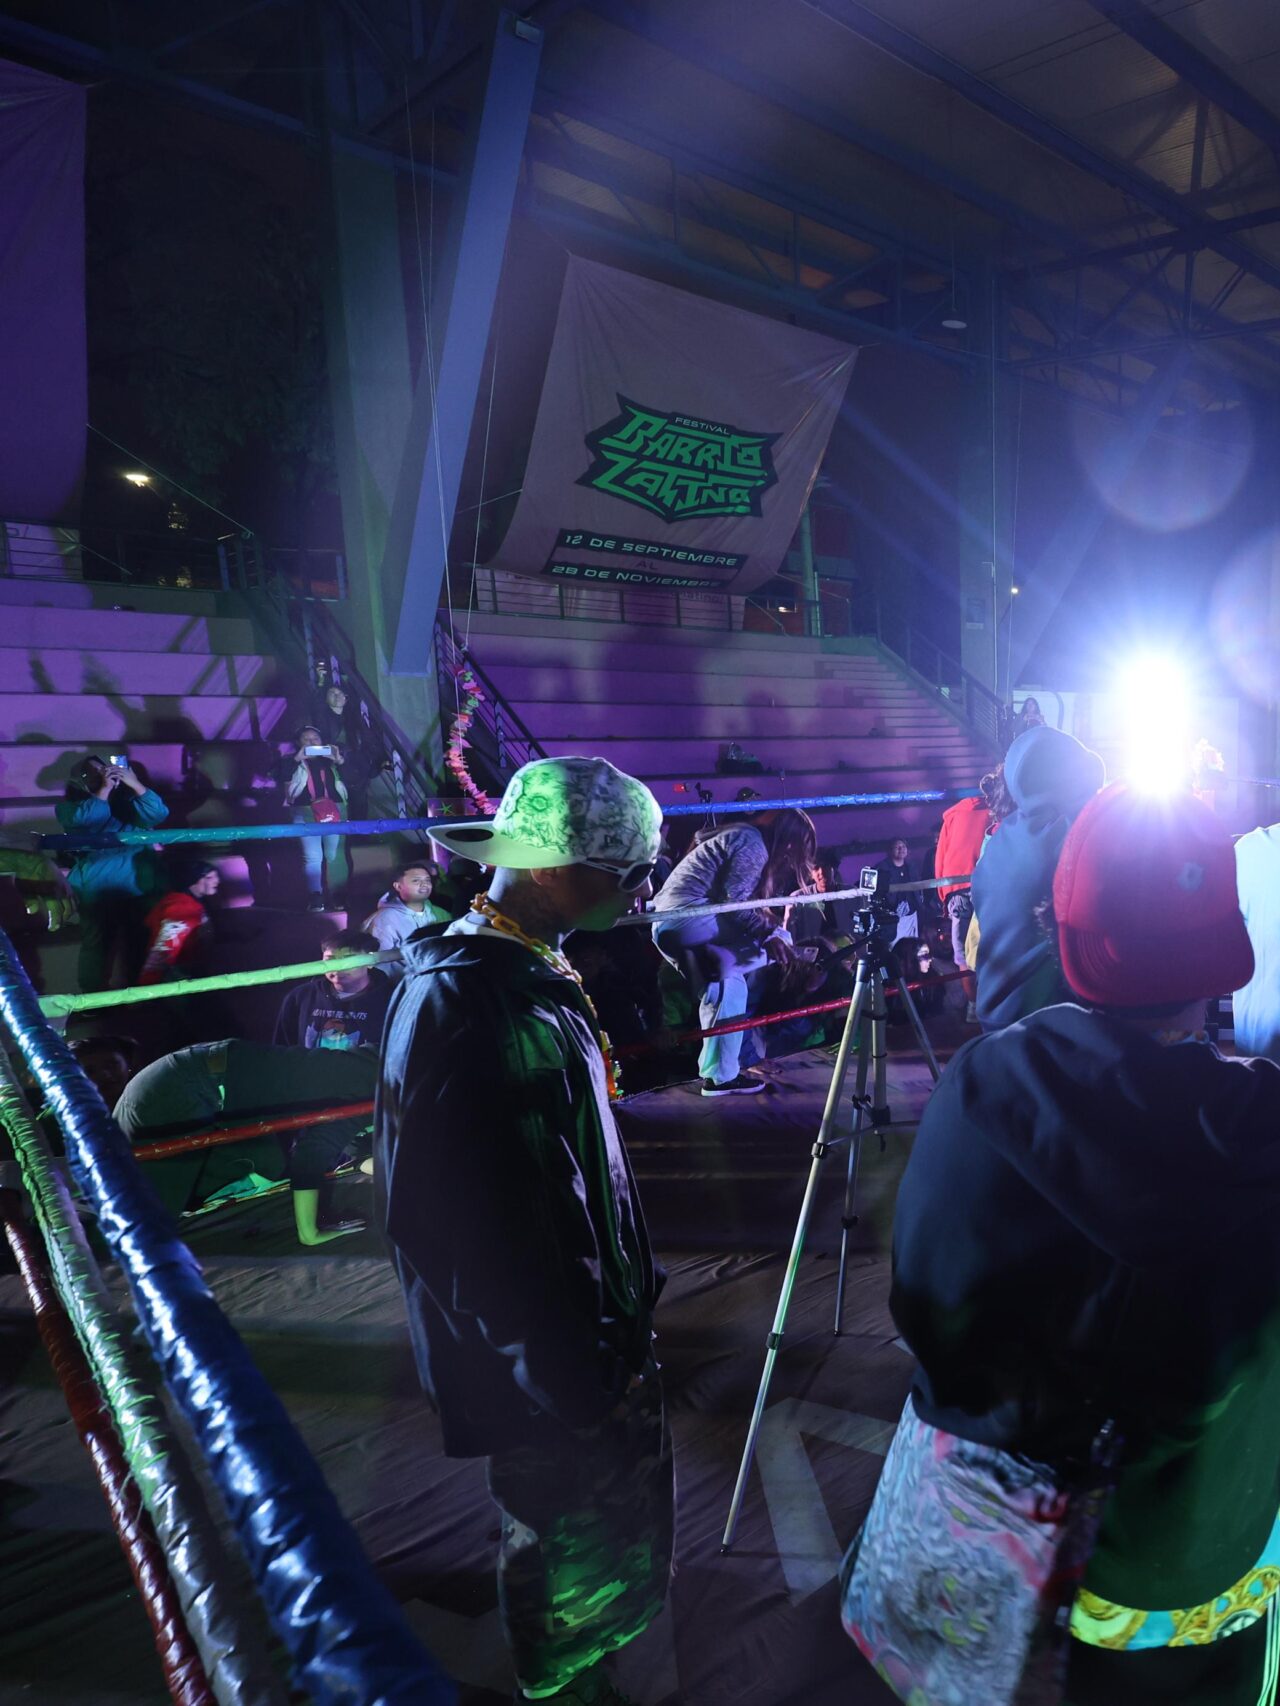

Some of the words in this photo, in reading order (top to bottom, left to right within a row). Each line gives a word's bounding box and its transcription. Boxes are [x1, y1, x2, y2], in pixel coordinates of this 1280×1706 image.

[675, 416, 731, 436] FESTIVAL
[598, 404, 769, 478] BARRIO
[564, 534, 583, 545] 12
[589, 537, 617, 549] DE
[621, 542, 738, 567] SEPTIEMBRE
[551, 565, 579, 576] 28
[583, 569, 612, 579] DE
[634, 560, 660, 571] AL
